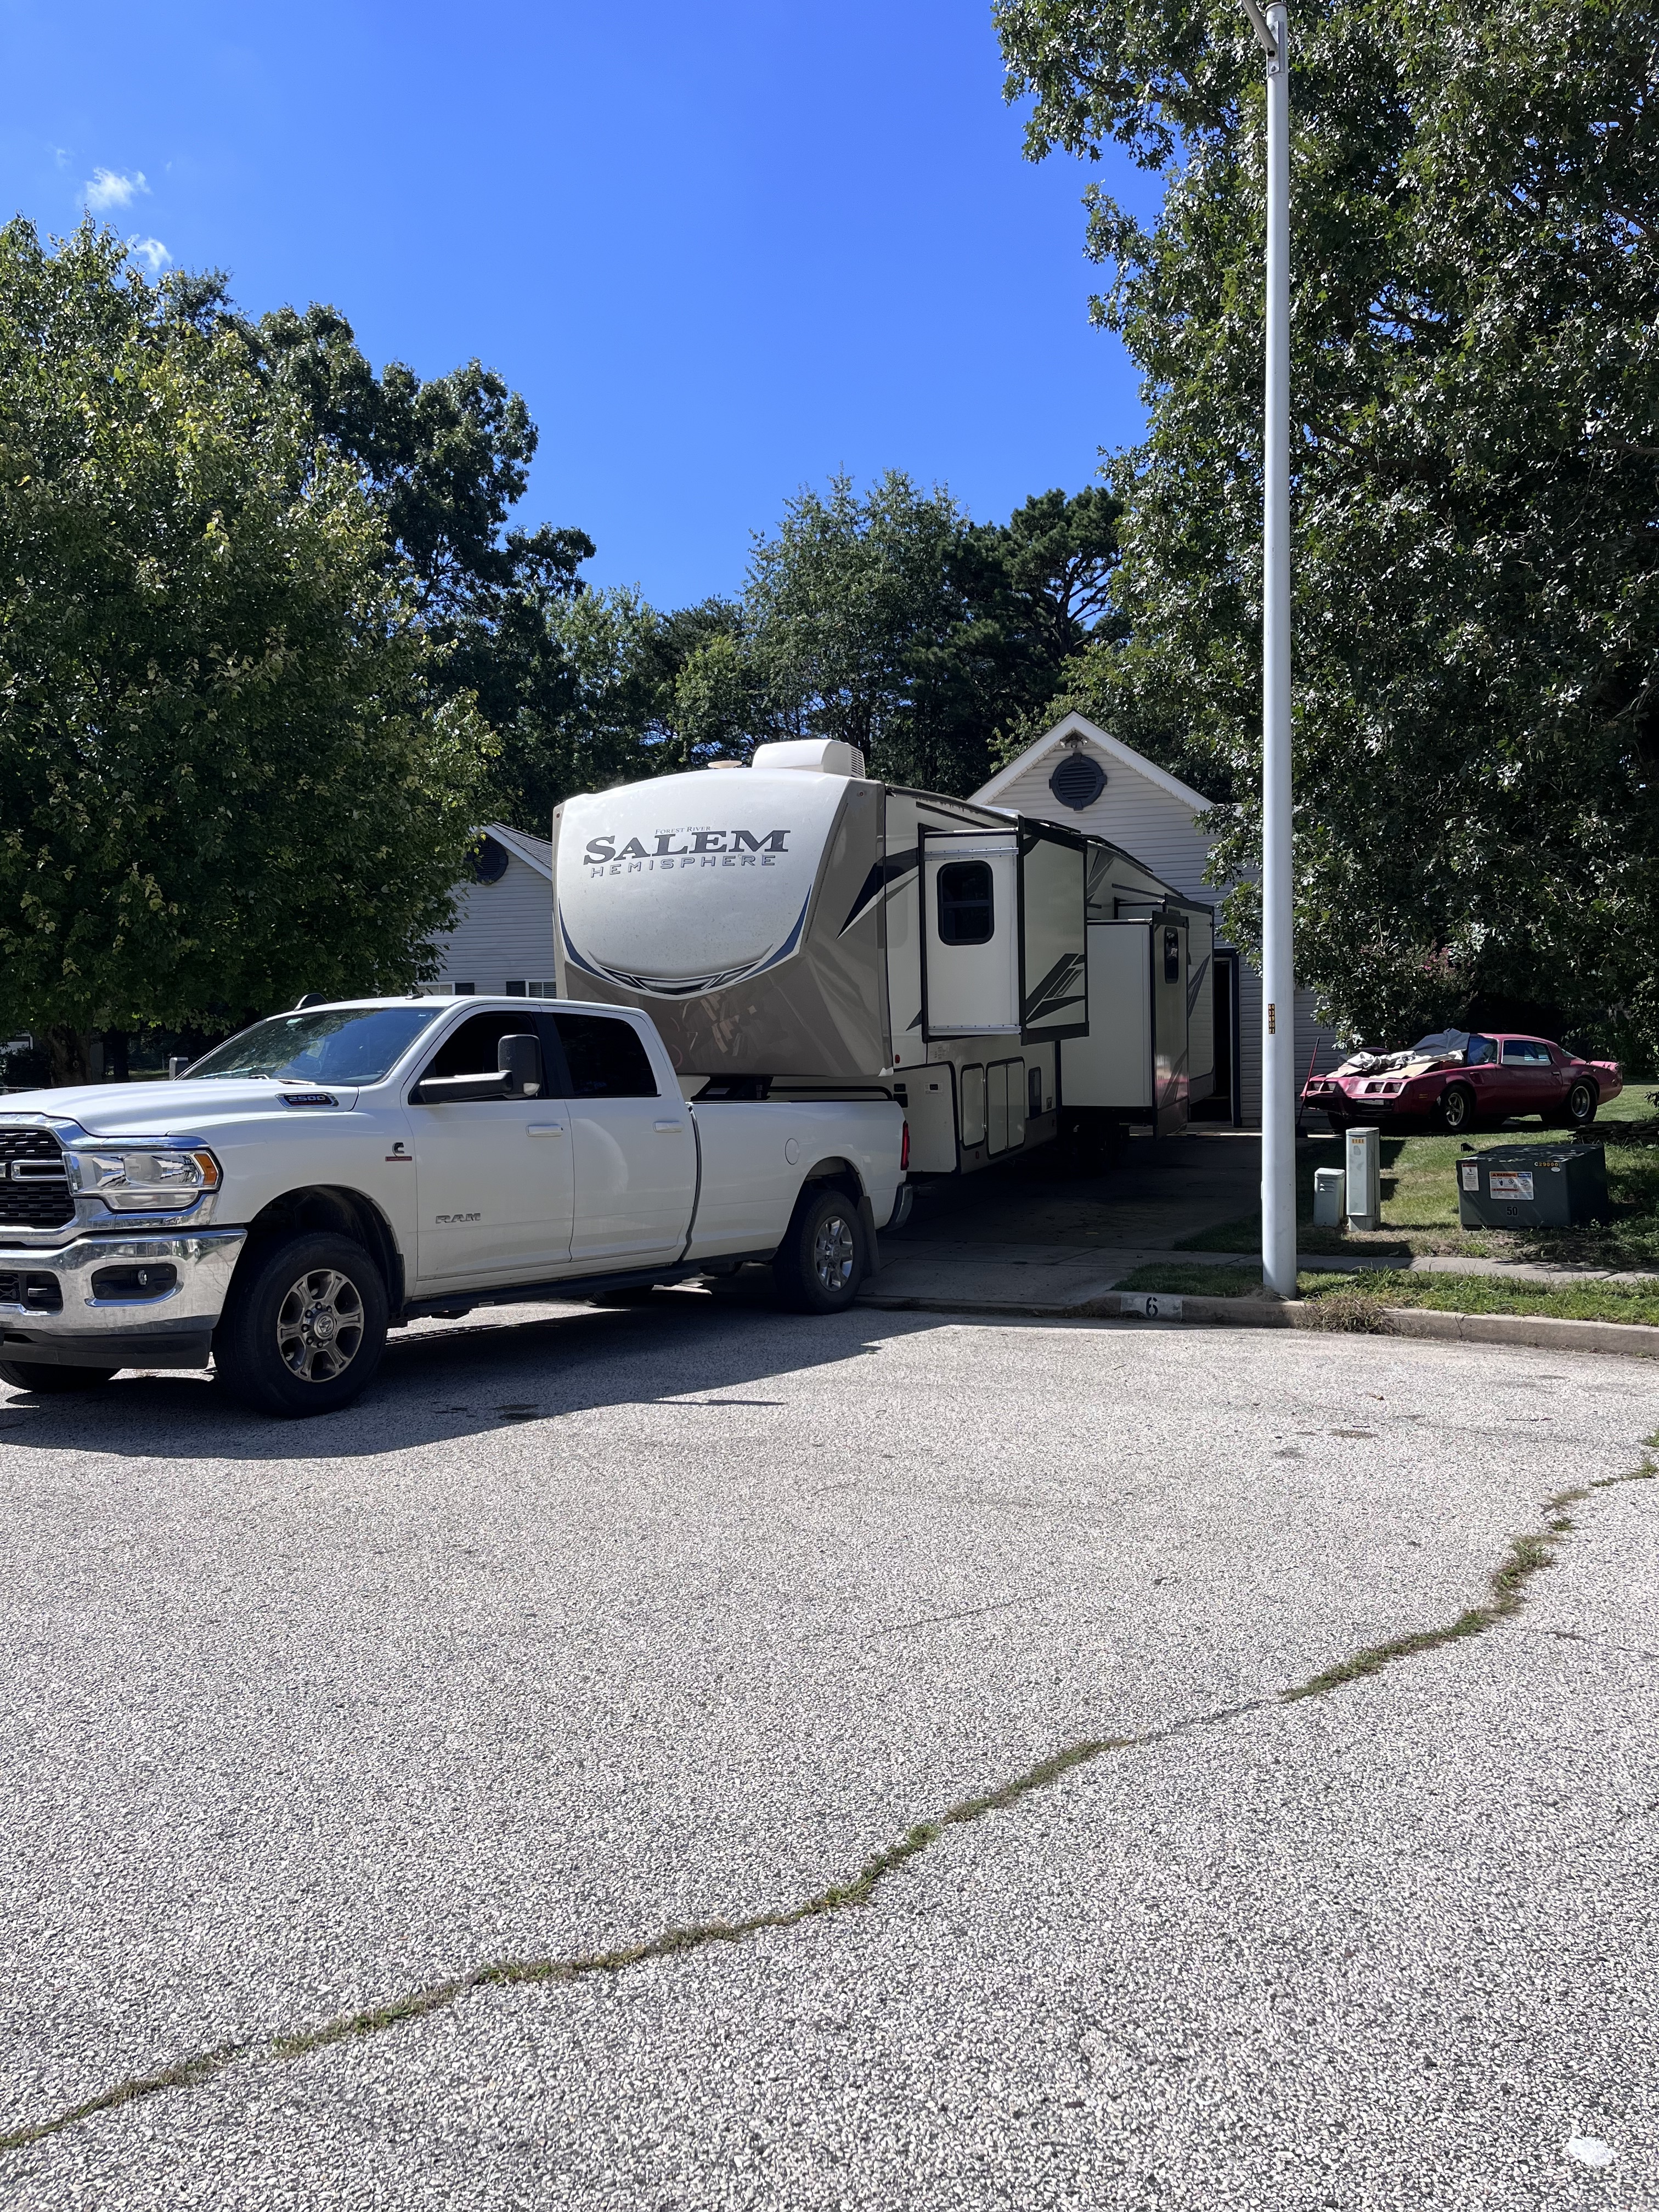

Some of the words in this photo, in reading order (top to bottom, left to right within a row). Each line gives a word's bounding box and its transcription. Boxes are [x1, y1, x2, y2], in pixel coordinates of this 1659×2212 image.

[583, 830, 791, 865] SALEM
[591, 855, 776, 878] HEMISPHERE
[436, 1212, 481, 1224] RAM
[1506, 1206, 1518, 1216] 50
[1146, 1297, 1158, 1317] 6
